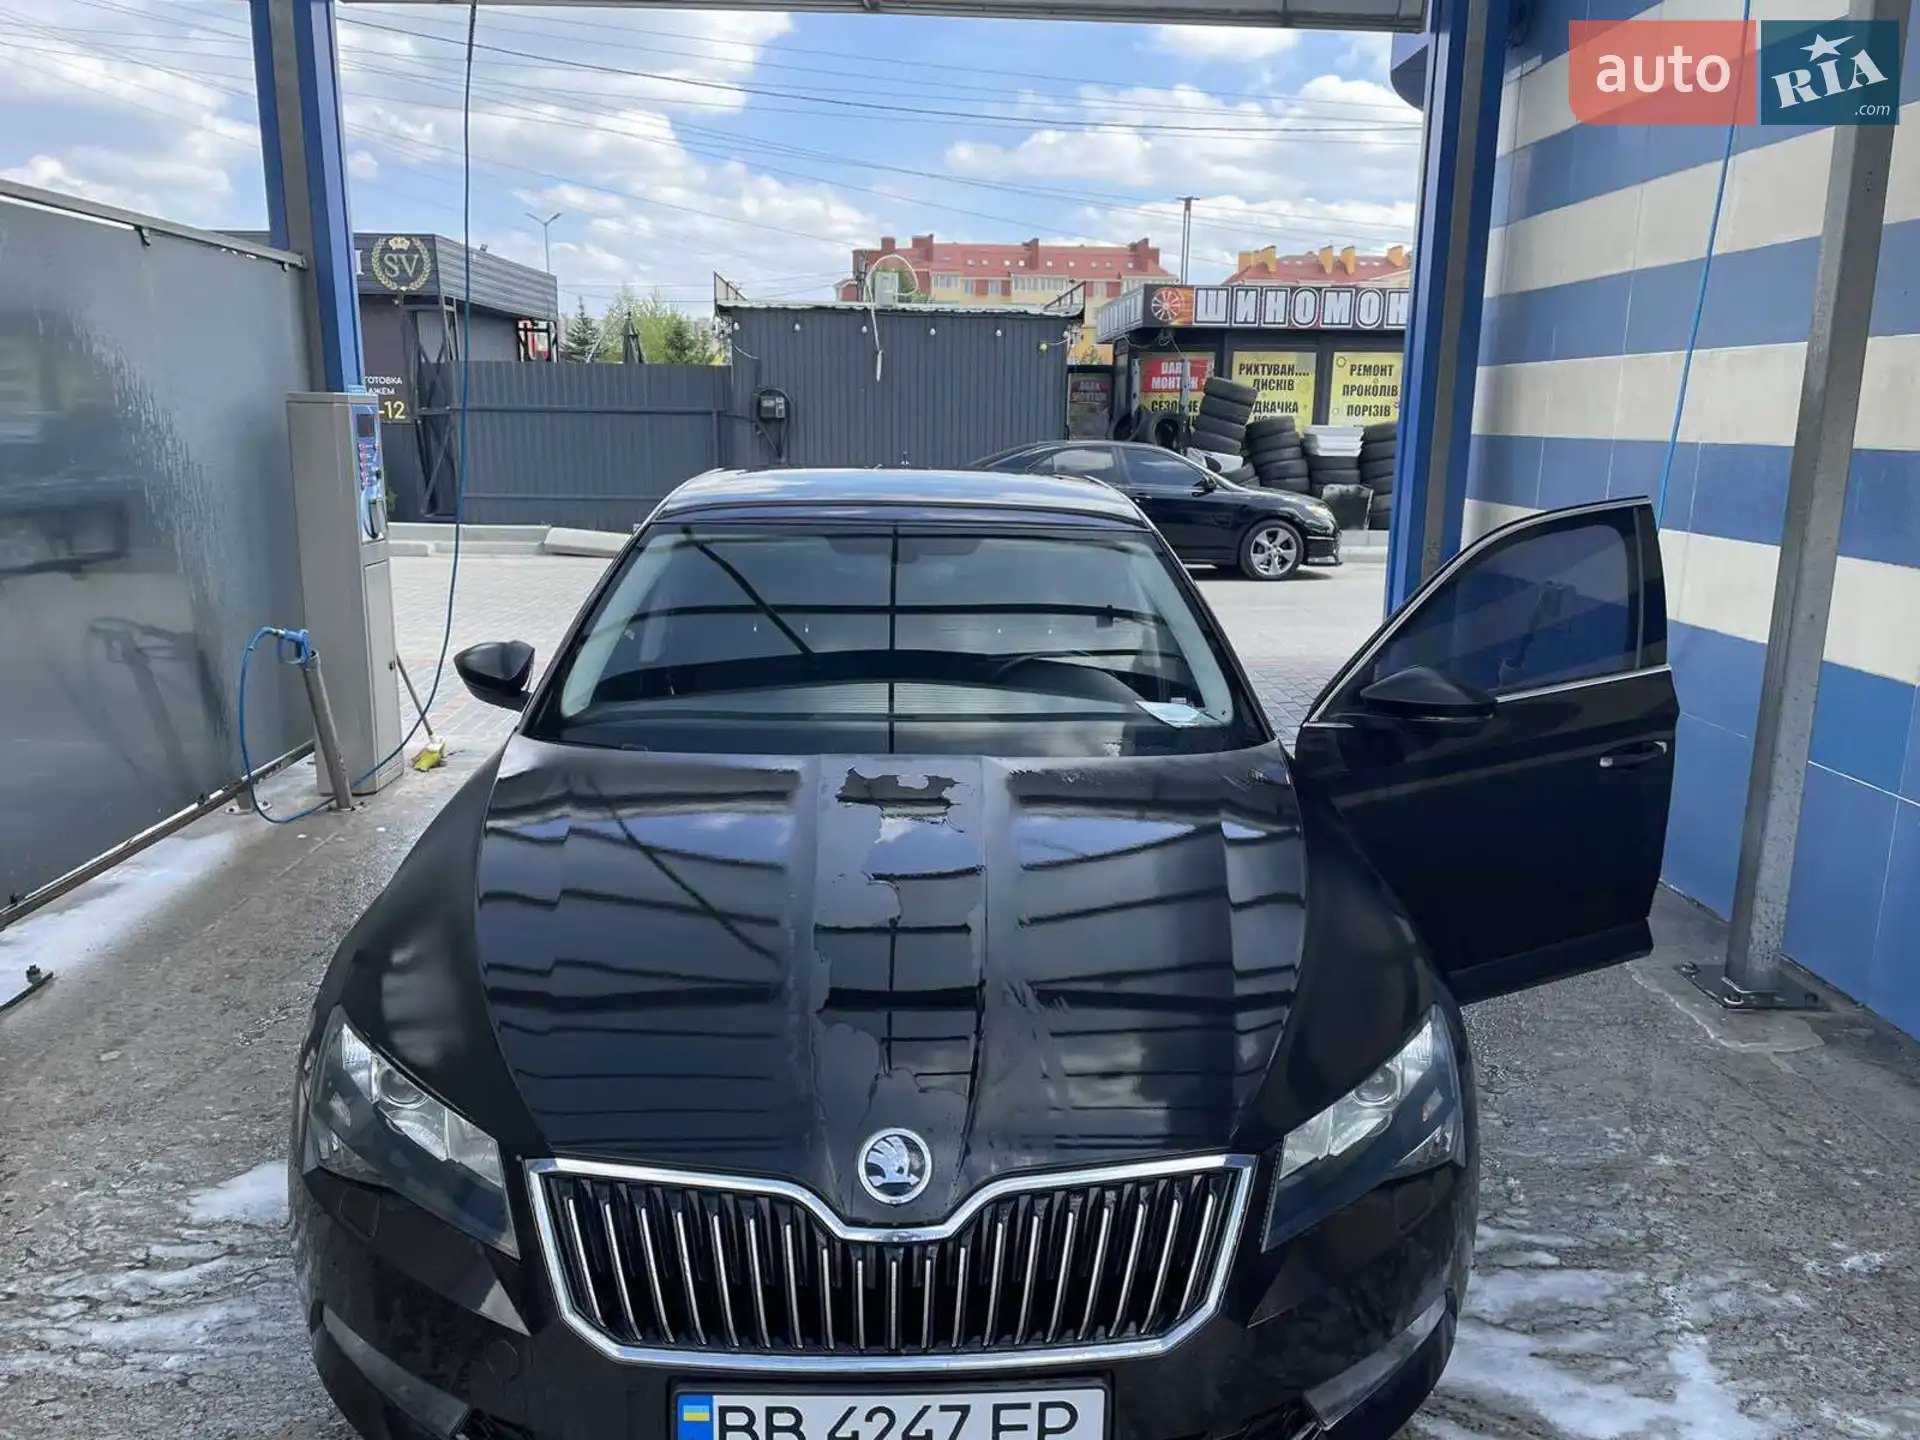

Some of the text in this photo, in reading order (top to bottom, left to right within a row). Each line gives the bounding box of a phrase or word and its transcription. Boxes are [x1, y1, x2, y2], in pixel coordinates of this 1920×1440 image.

[384, 253, 420, 278] SV
[1350, 364, 1394, 377] РЕМОНТ
[1151, 376, 1199, 389] МОНТЖ
[1252, 378, 1295, 391] ДИСКІВ
[1342, 384, 1398, 397] ПРОКОЛІВ
[1346, 404, 1391, 417] ПОРІЗІВ
[718, 1404, 806, 1440] BB
[826, 1403, 972, 1440] 4247
